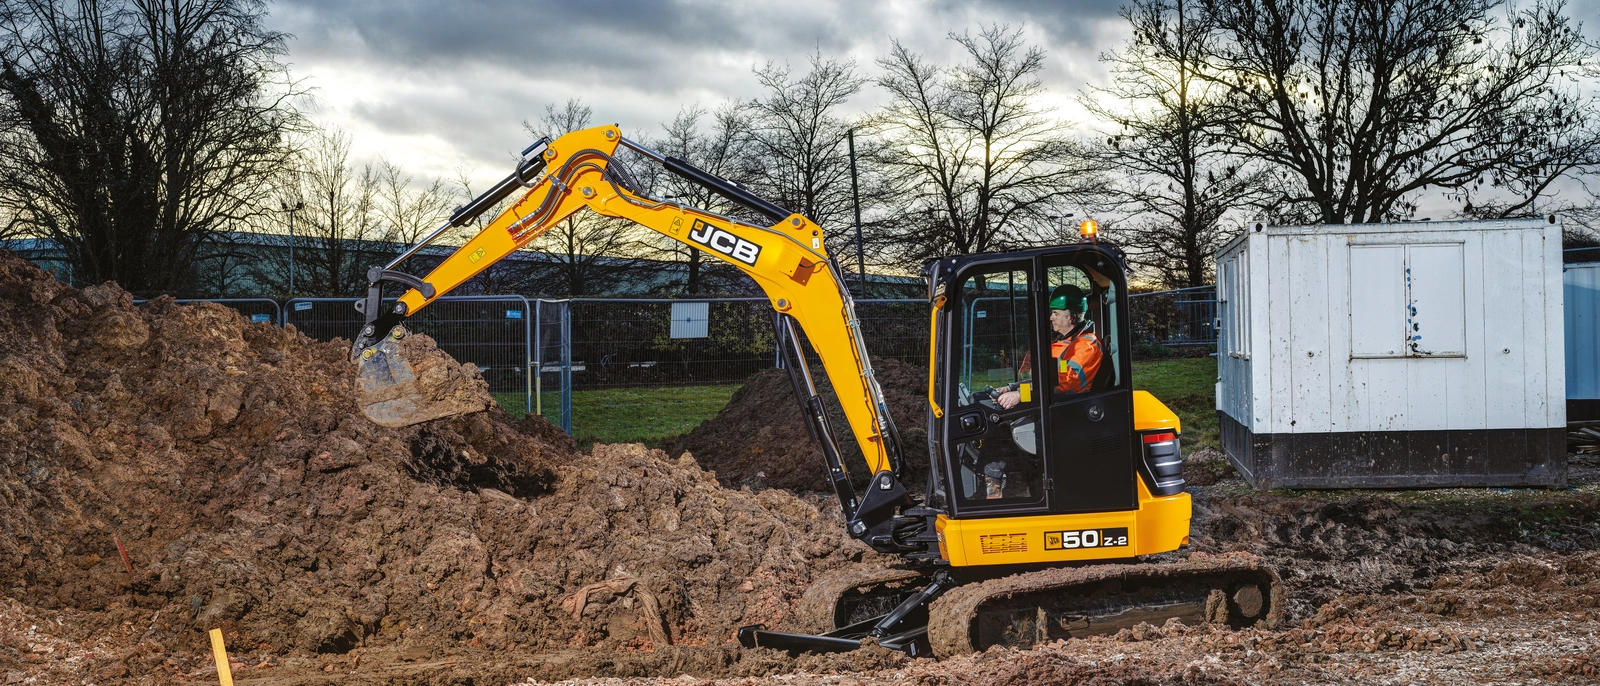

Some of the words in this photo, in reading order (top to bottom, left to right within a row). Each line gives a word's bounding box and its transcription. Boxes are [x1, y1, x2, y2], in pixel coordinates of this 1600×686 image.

[690, 225, 759, 264] JCB
[1063, 530, 1099, 548] 50
[1104, 536, 1127, 546] Z-2
